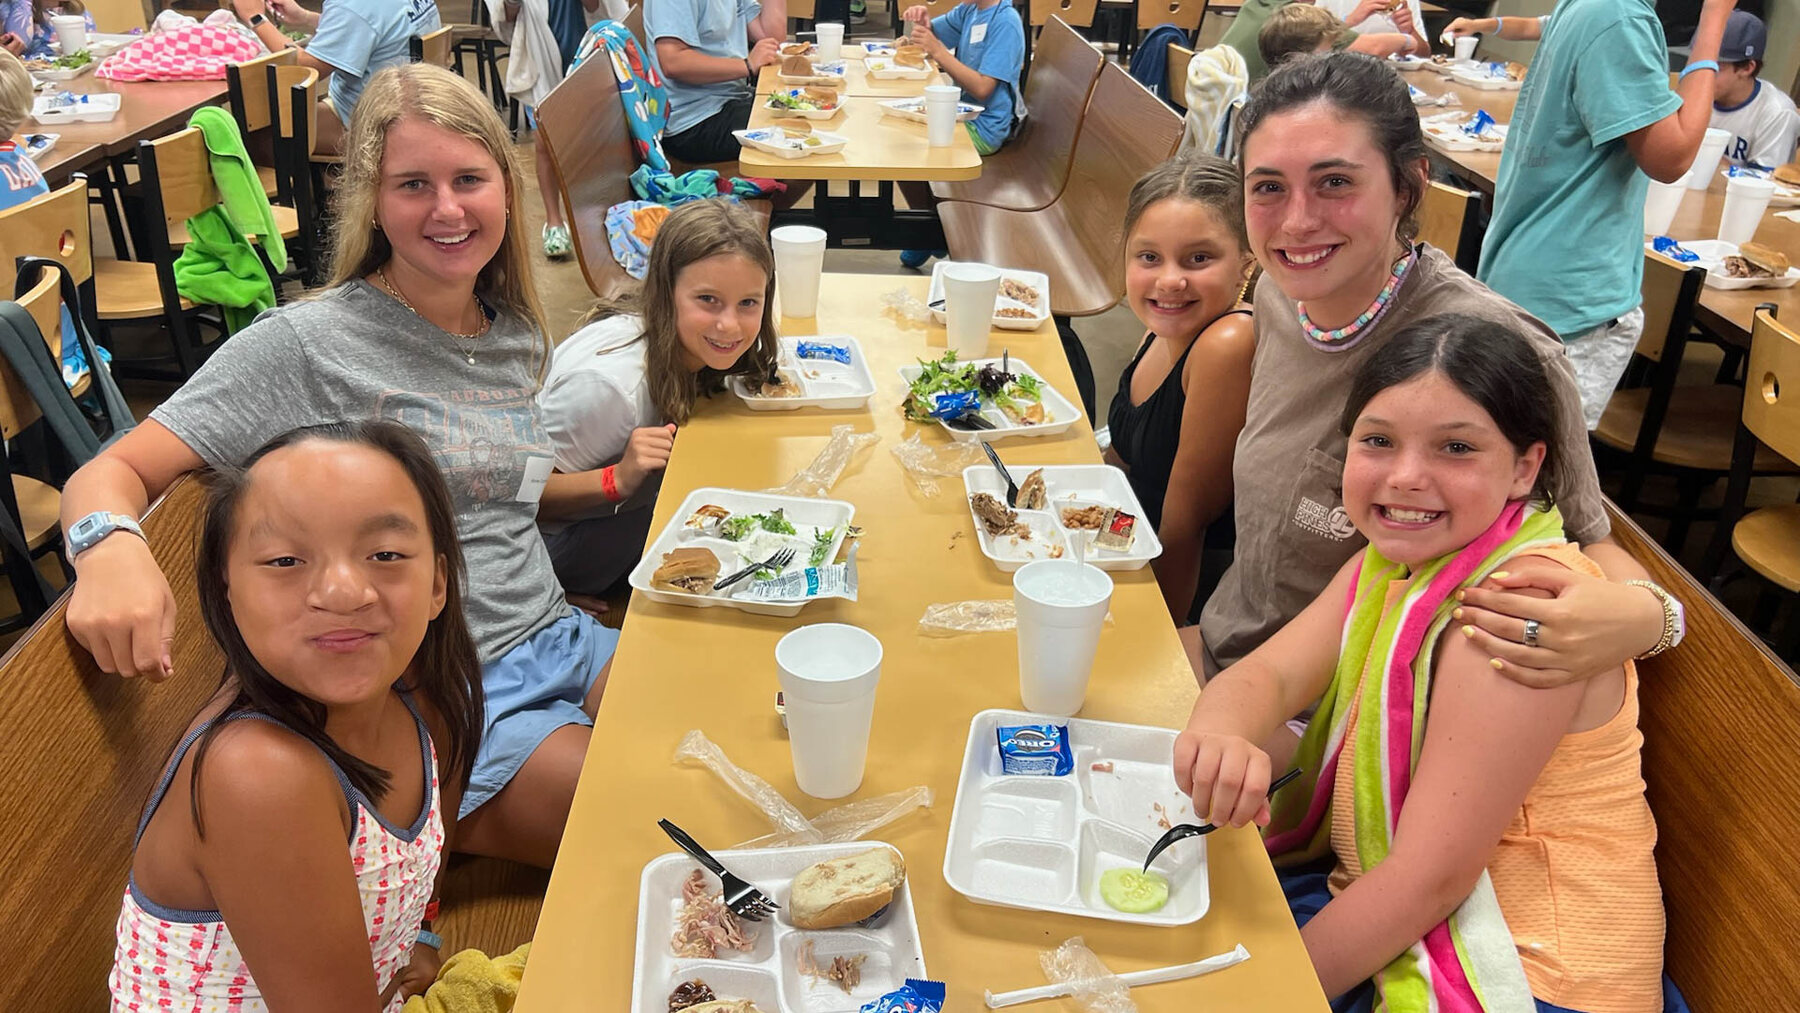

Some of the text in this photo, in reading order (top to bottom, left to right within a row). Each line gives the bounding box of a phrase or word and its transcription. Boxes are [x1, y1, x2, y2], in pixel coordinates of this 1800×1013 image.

[1300, 497, 1329, 519] HIGH
[1294, 520, 1340, 542] OUTFITTERS
[1295, 508, 1331, 532] PINES
[1007, 738, 1056, 748] OREO
